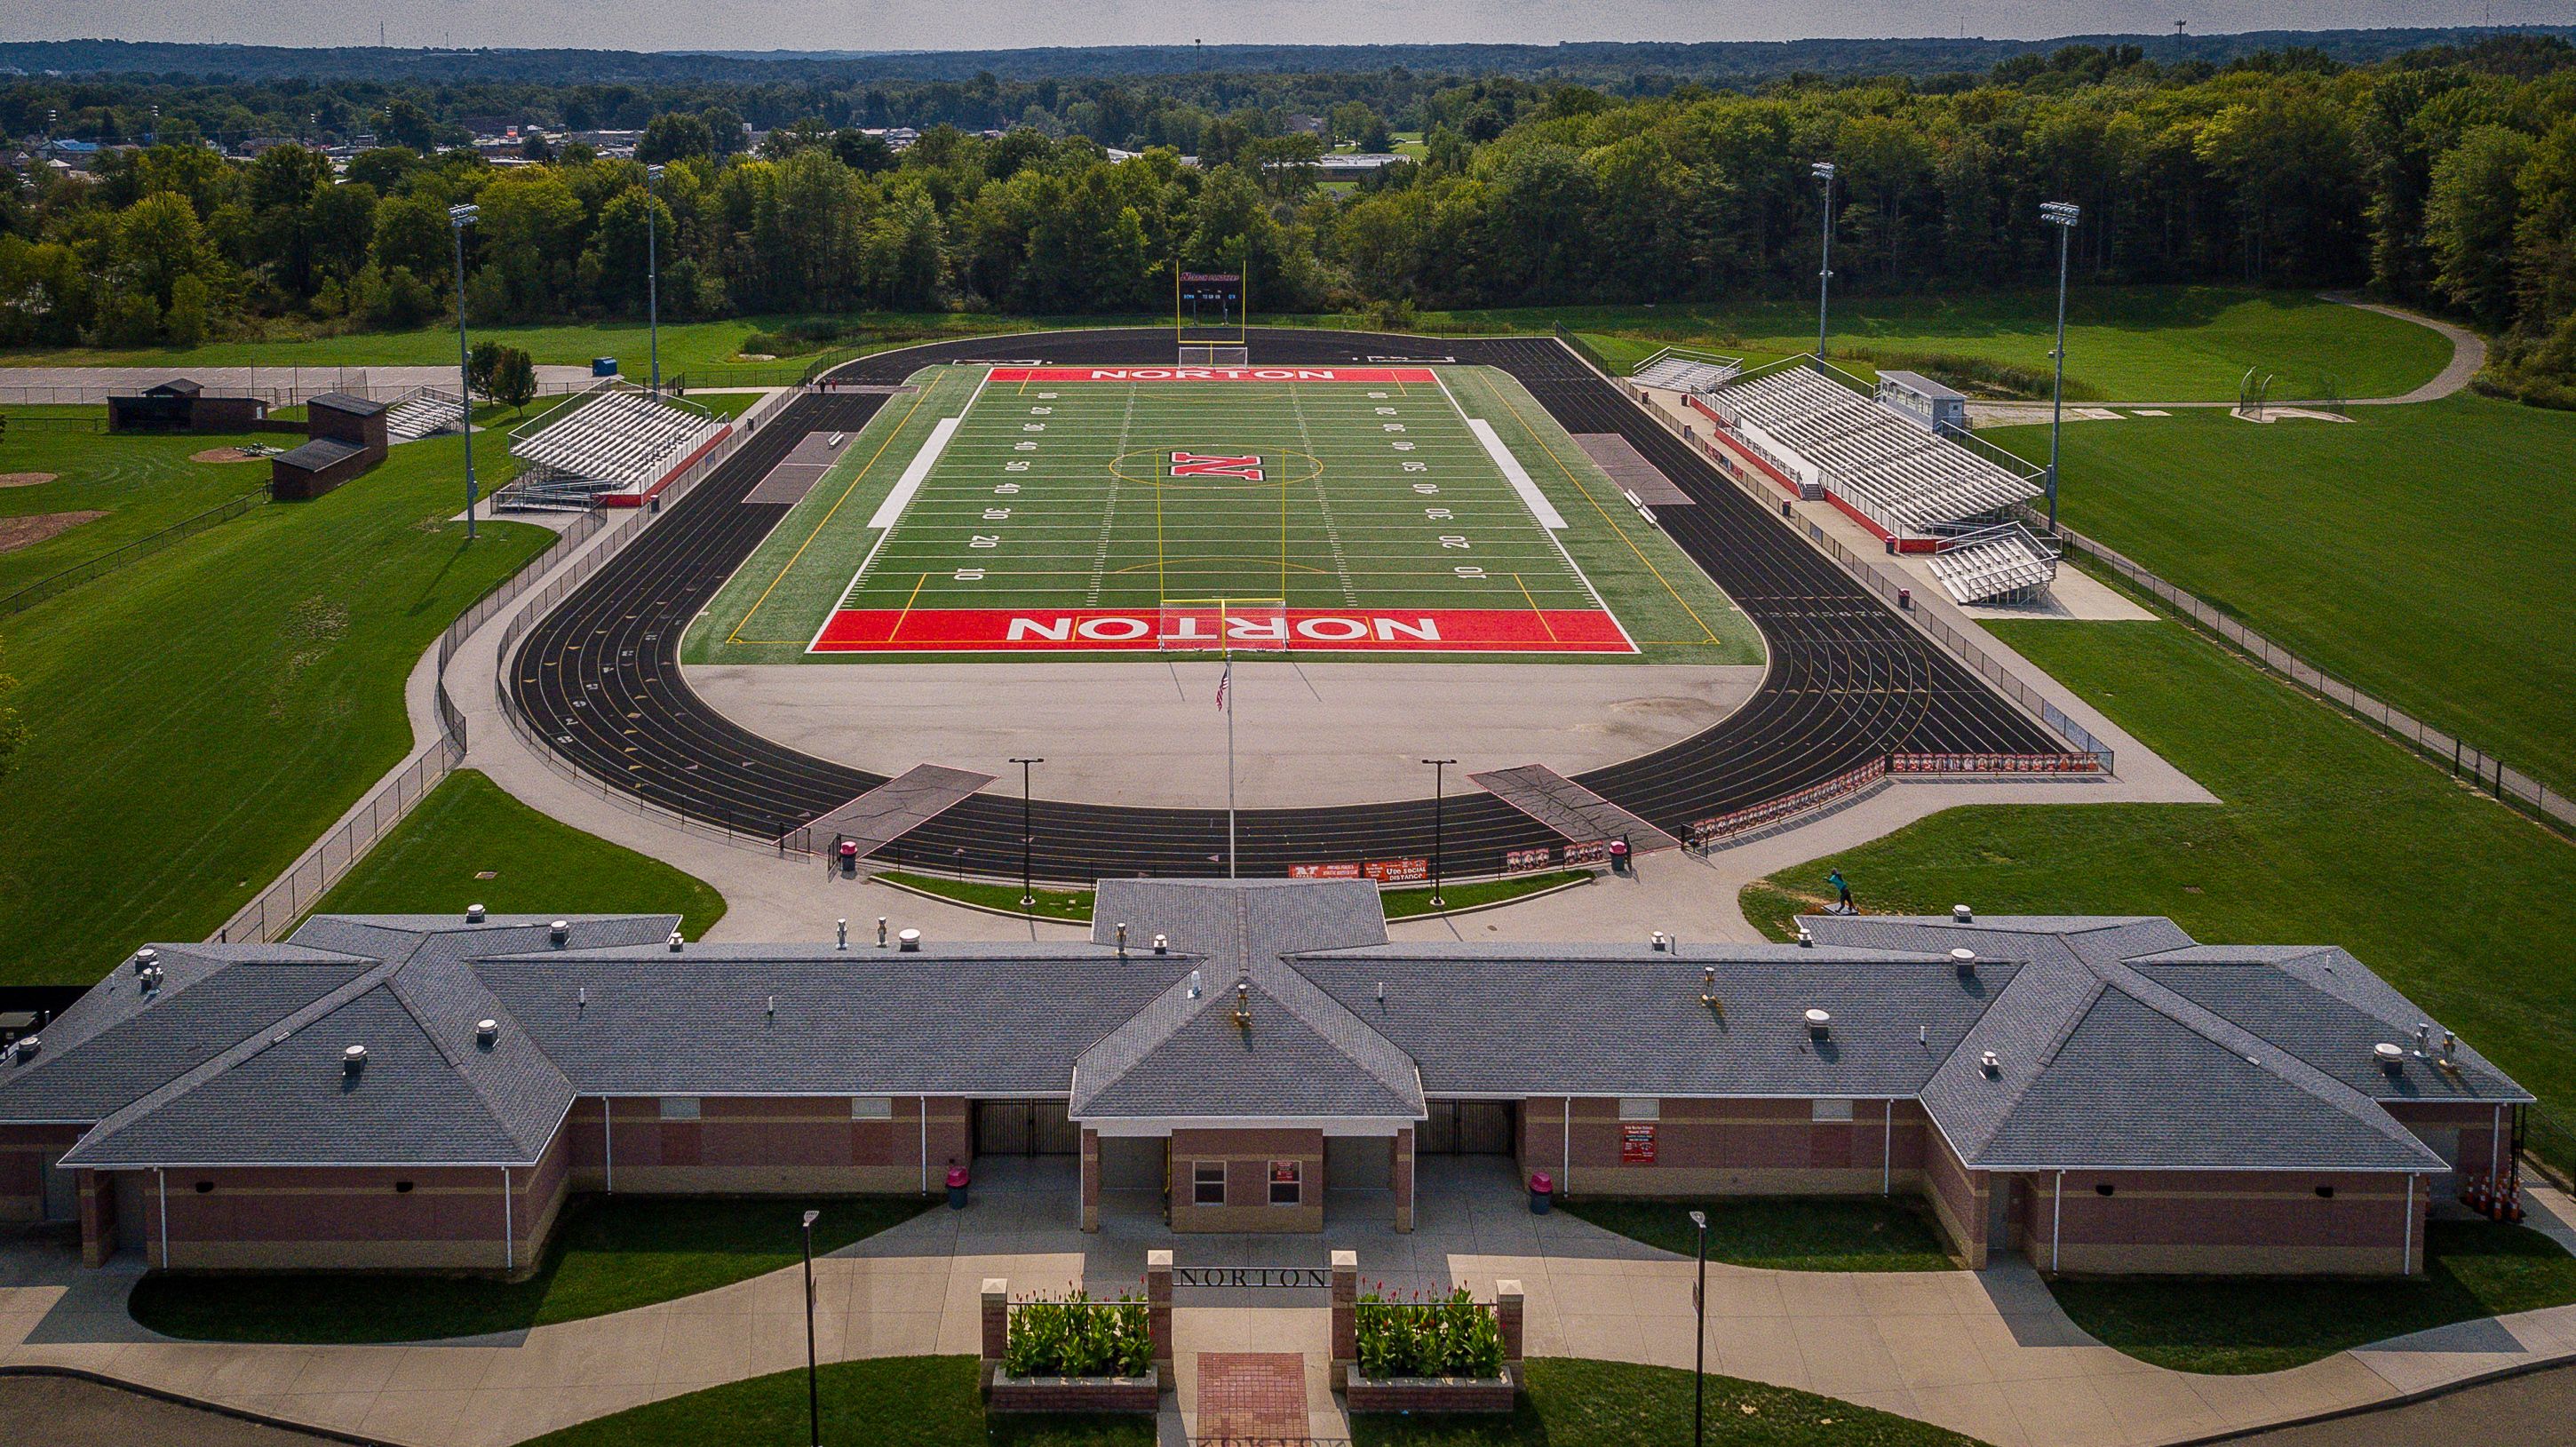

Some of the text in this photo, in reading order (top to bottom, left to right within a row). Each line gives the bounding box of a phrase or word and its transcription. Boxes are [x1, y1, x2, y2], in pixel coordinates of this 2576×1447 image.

[1091, 370, 1335, 379] NORTON
[1014, 441, 1038, 450] 40
[1391, 441, 1416, 451] 40
[1005, 461, 1030, 471] 50
[1401, 461, 1427, 472] 50
[994, 482, 1021, 494] 40
[1412, 483, 1440, 494] 40
[982, 507, 1012, 520] 30
[1425, 508, 1454, 520] 30
[969, 535, 1000, 548] 20
[1438, 535, 1470, 549] 20
[954, 568, 985, 580] 10
[1454, 566, 1487, 579] 10
[1006, 616, 1442, 640] NORTON
[1180, 1268, 1326, 1287] NORTON
